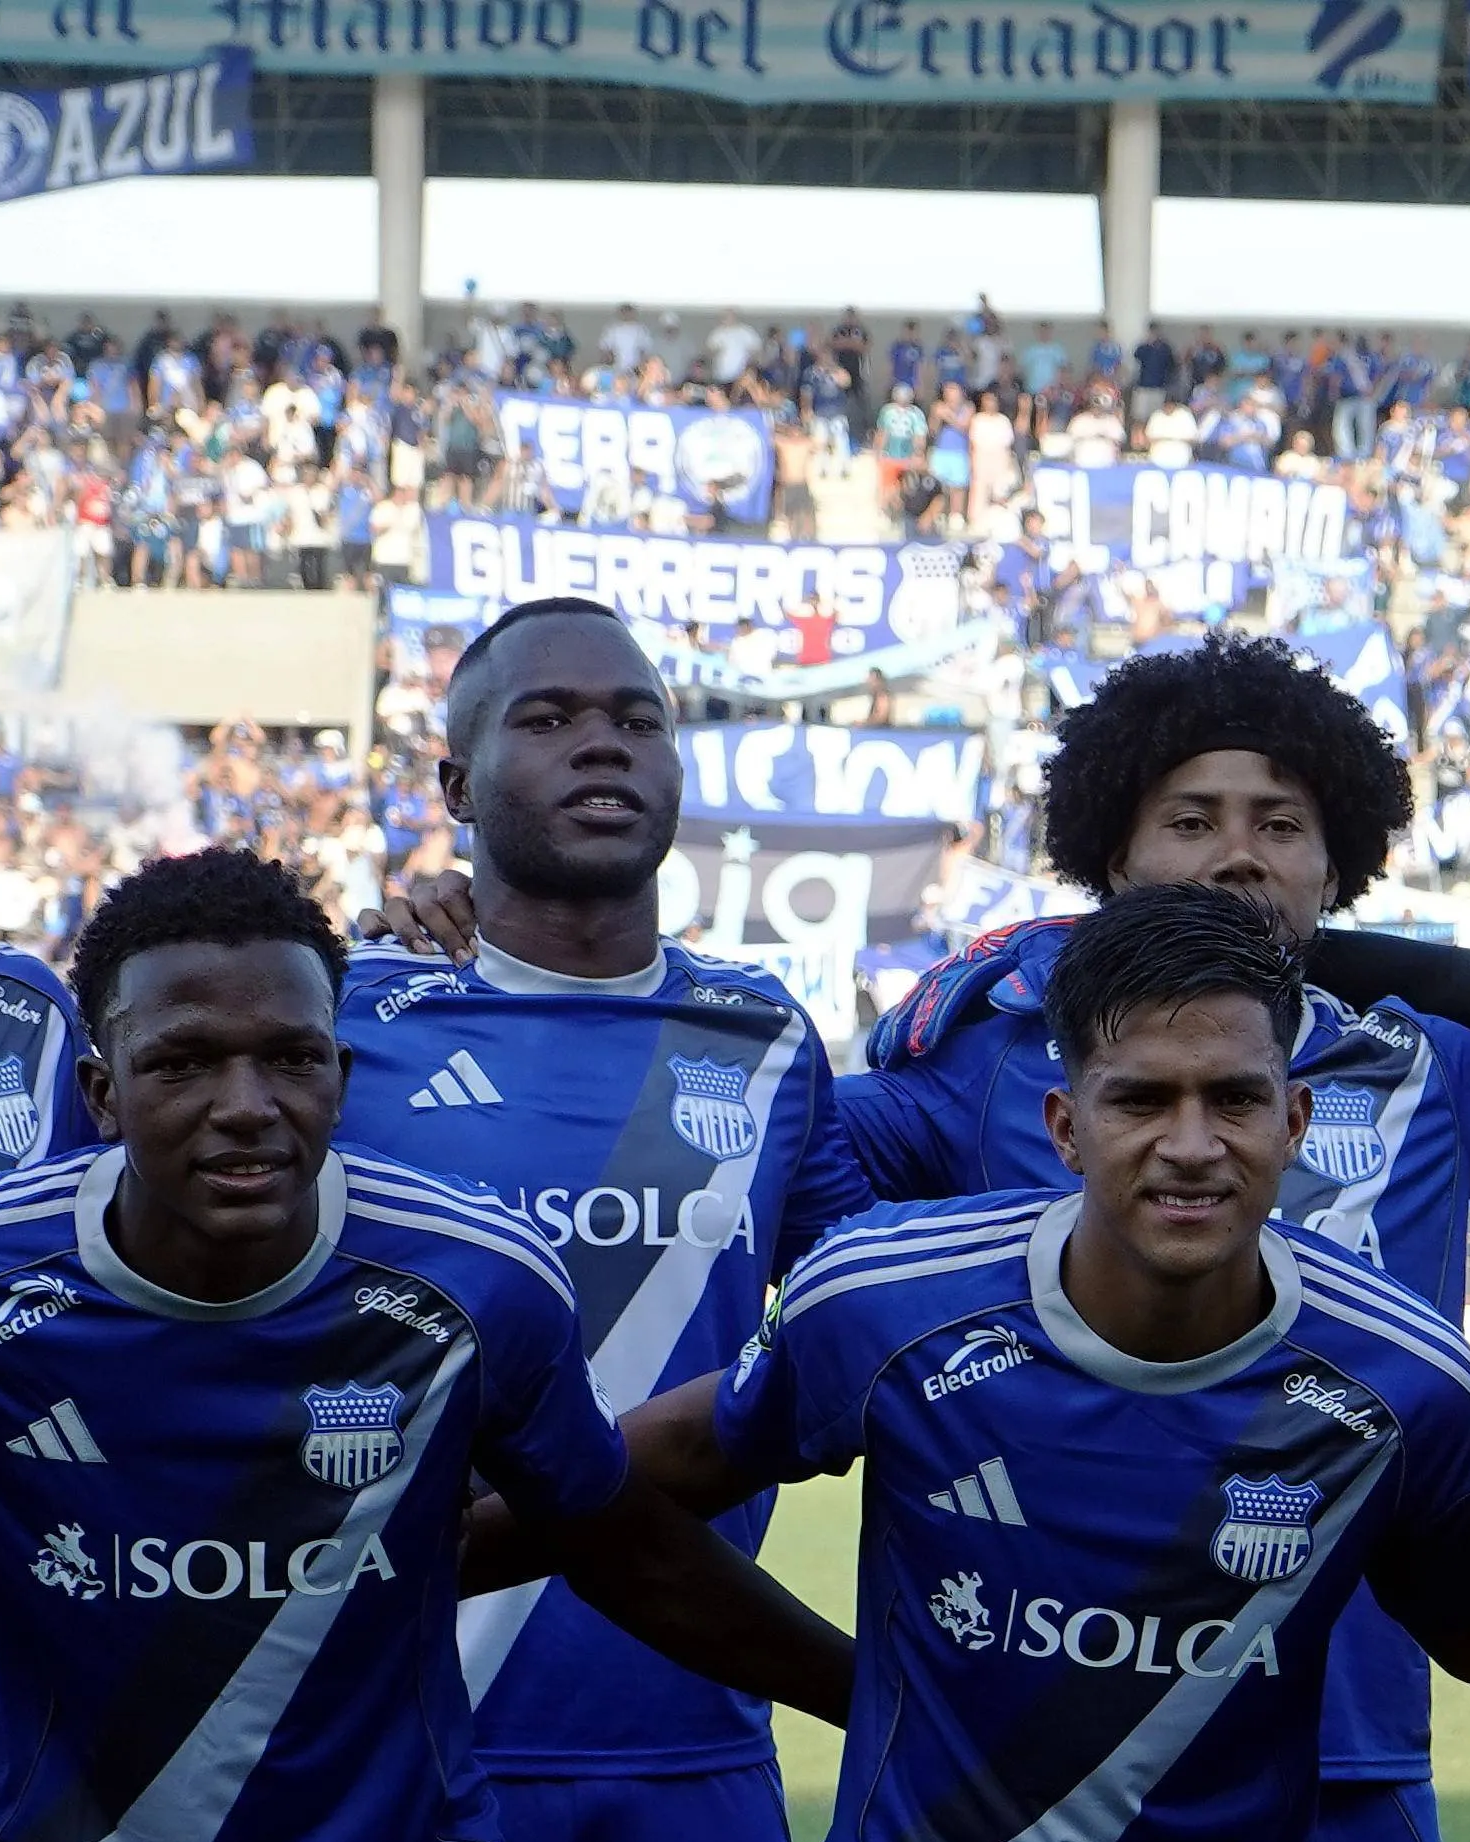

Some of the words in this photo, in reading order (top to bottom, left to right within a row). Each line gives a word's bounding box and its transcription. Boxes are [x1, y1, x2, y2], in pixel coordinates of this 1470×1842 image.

[824, 0, 1251, 80] Ecuador
[44, 62, 234, 191] AZUL
[449, 519, 887, 626] GUERREROS
[674, 1094, 756, 1156] EMELEC
[1302, 1125, 1386, 1182] EMELEC
[537, 1186, 756, 1256] SOLCA
[354, 1284, 452, 1345] Splendor
[923, 1341, 1034, 1402] Electrolit
[1284, 1373, 1378, 1441] Splendor
[304, 1429, 399, 1487] EMELEC
[129, 1532, 397, 1600] SOLCA
[1217, 1523, 1311, 1580] EMELEC
[1017, 1596, 1281, 1678] SOLCA
